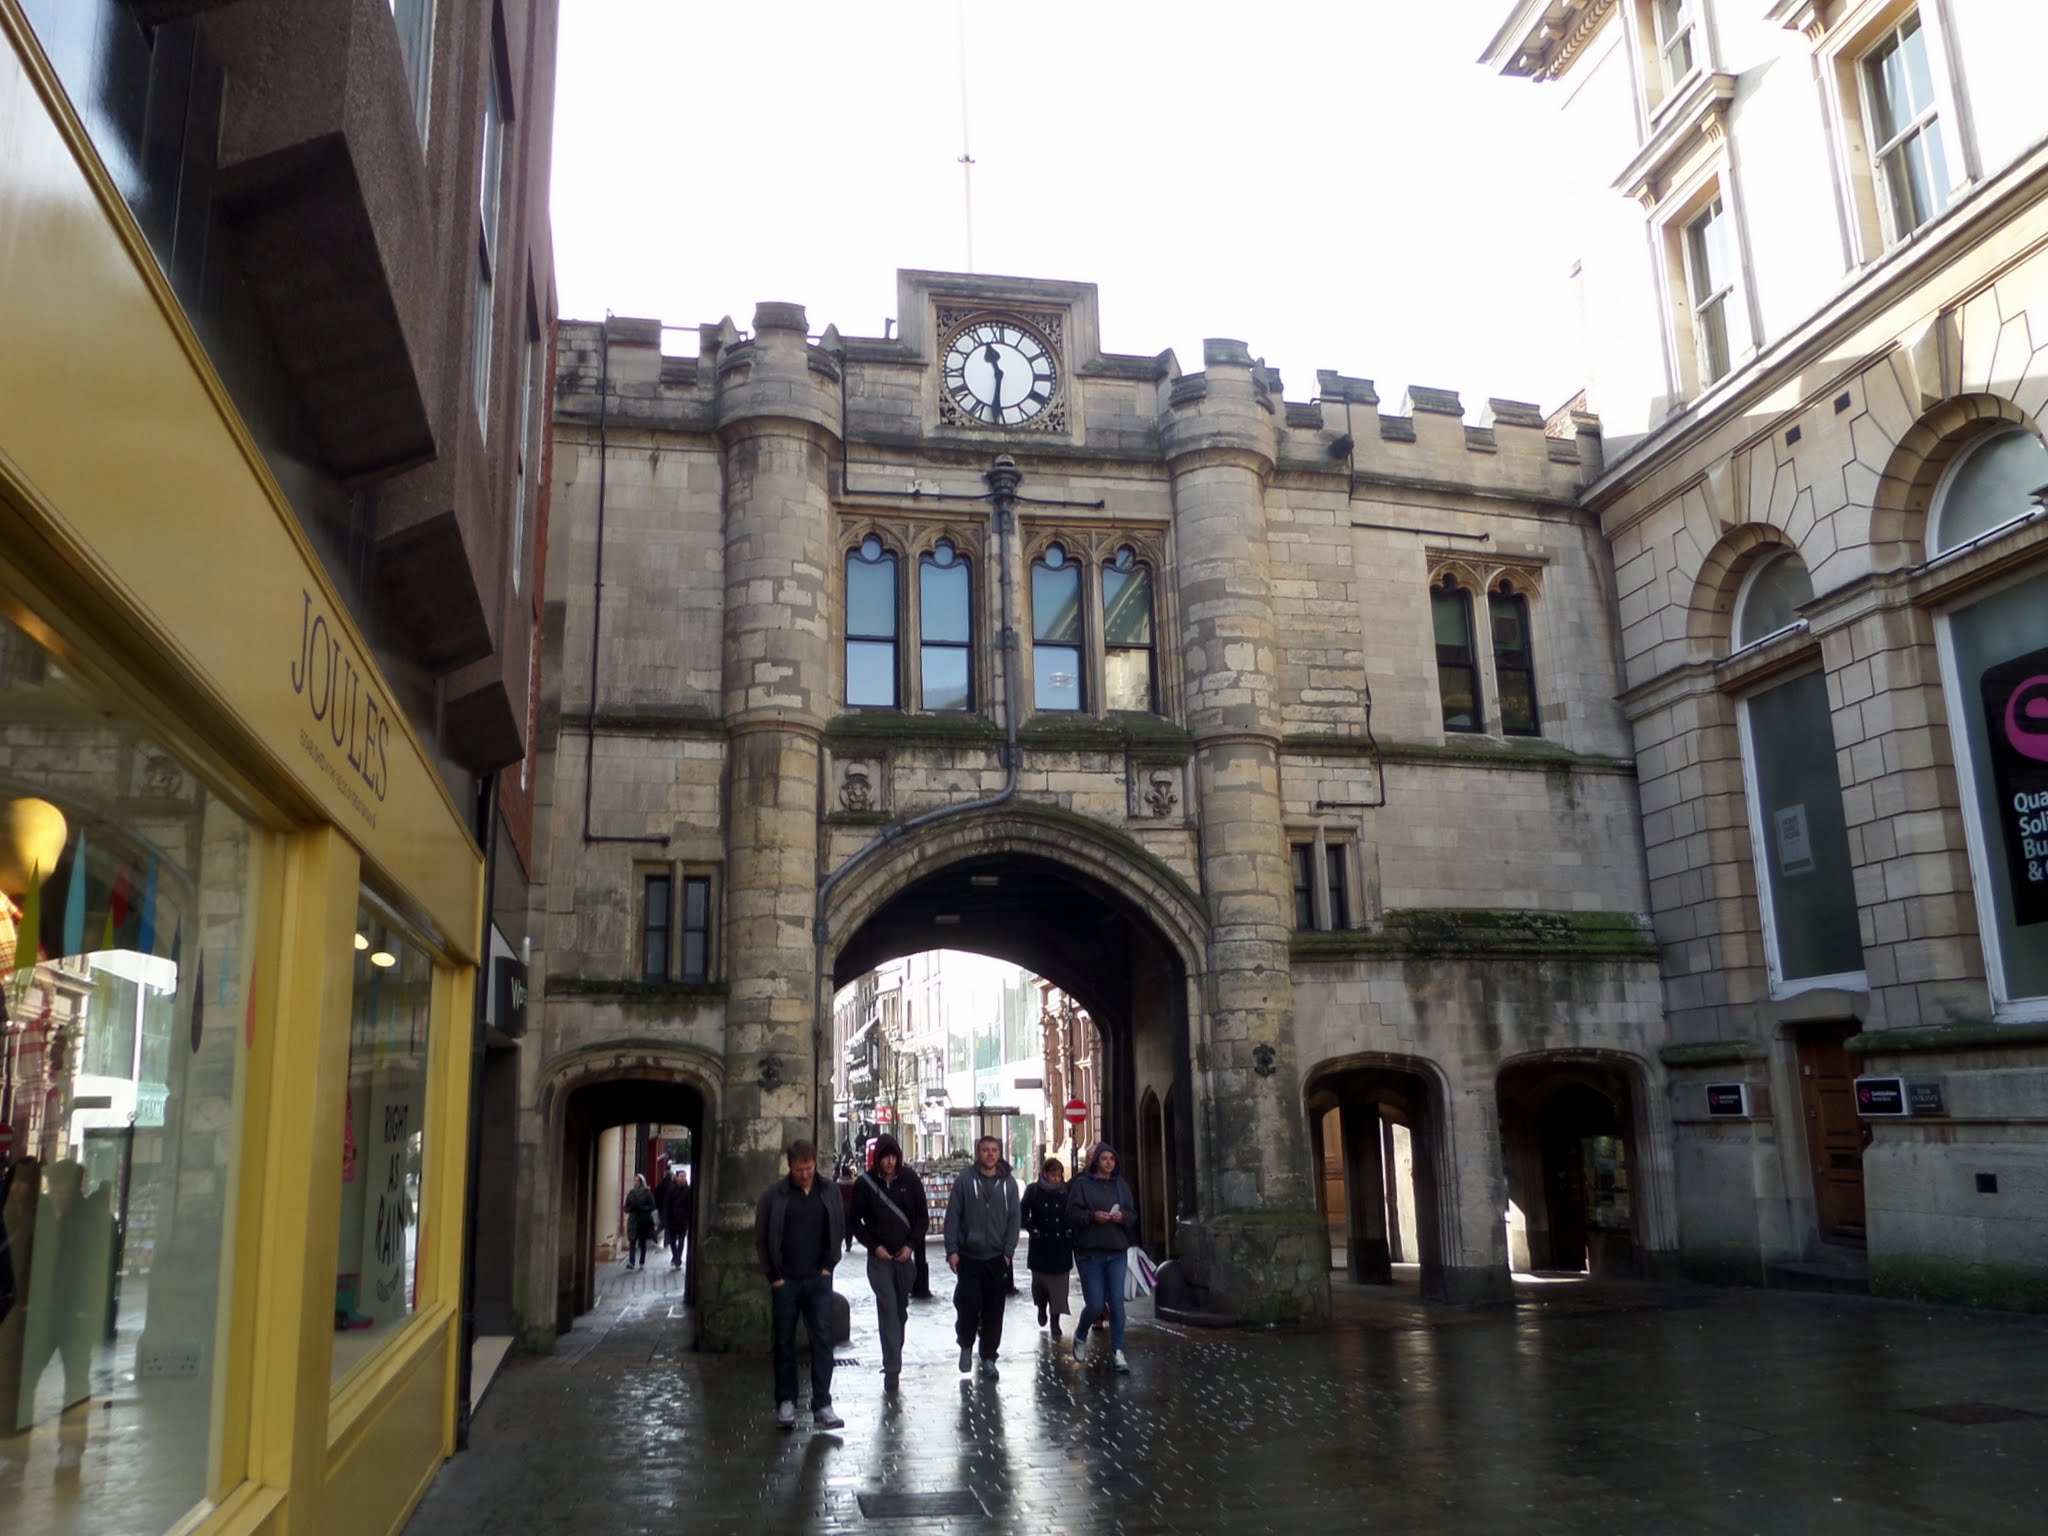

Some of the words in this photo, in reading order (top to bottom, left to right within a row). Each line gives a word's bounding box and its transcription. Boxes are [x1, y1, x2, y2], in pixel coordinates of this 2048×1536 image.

[291, 588, 389, 802] JOULES
[2028, 860, 2043, 881] &
[384, 1104, 408, 1144] RIGHT
[387, 1153, 399, 1193] AS
[375, 1190, 405, 1267] RAIN
